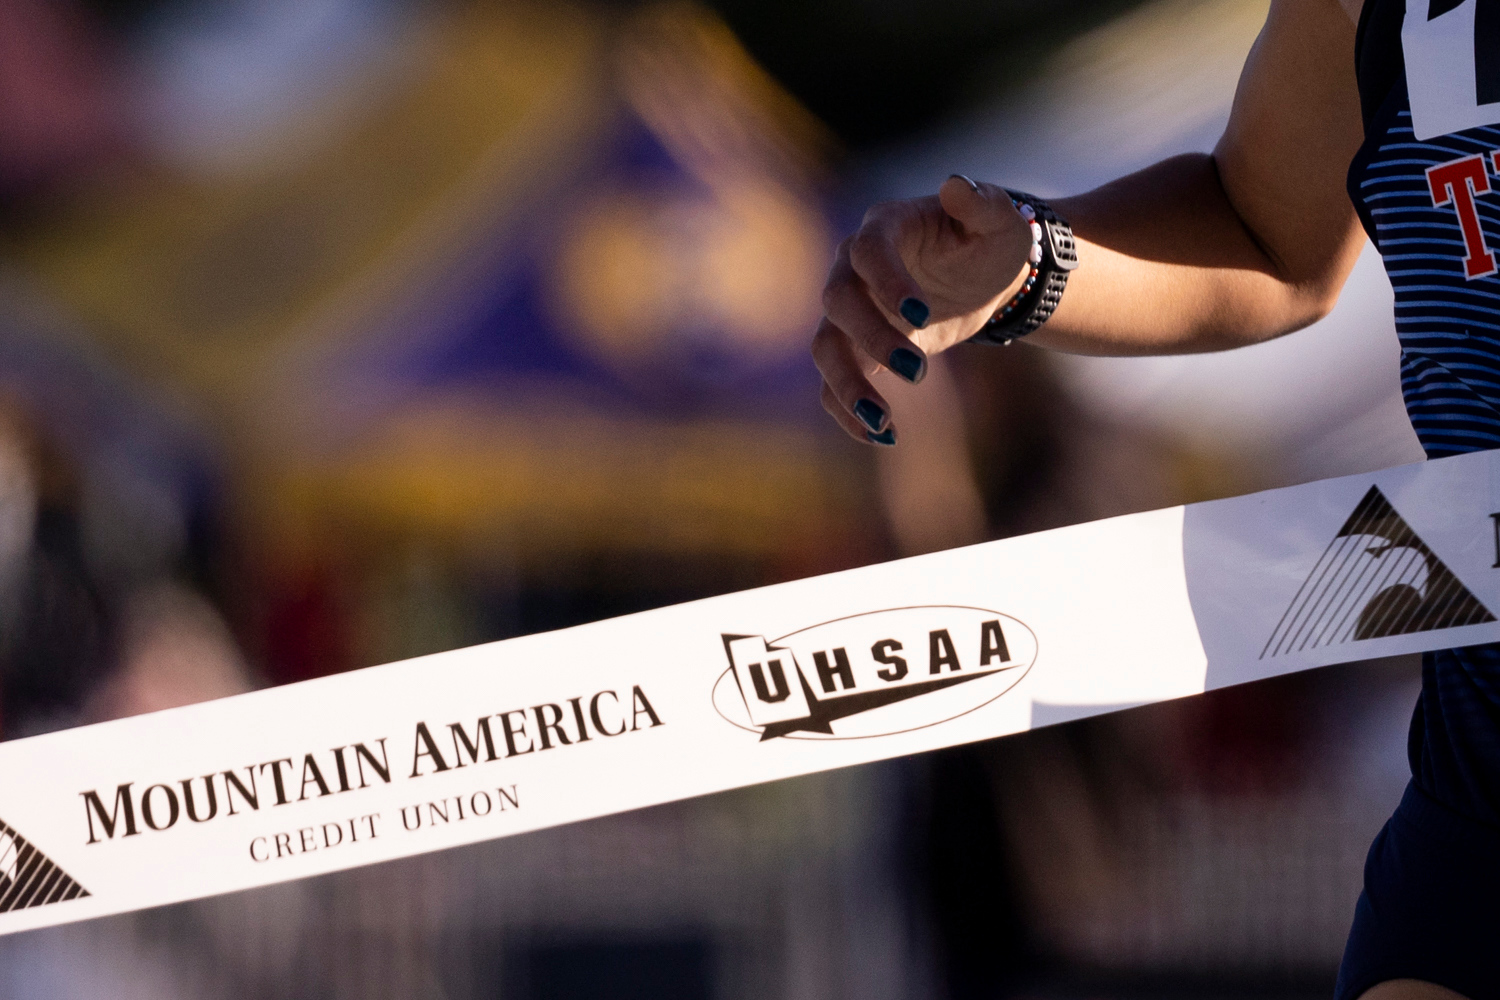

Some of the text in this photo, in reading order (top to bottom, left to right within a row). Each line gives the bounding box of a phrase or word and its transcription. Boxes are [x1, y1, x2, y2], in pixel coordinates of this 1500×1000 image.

[748, 619, 1011, 703] UHSAA
[78, 684, 666, 845] MOUNTAIN AMERICA
[248, 784, 521, 863] CREDIT UNION
